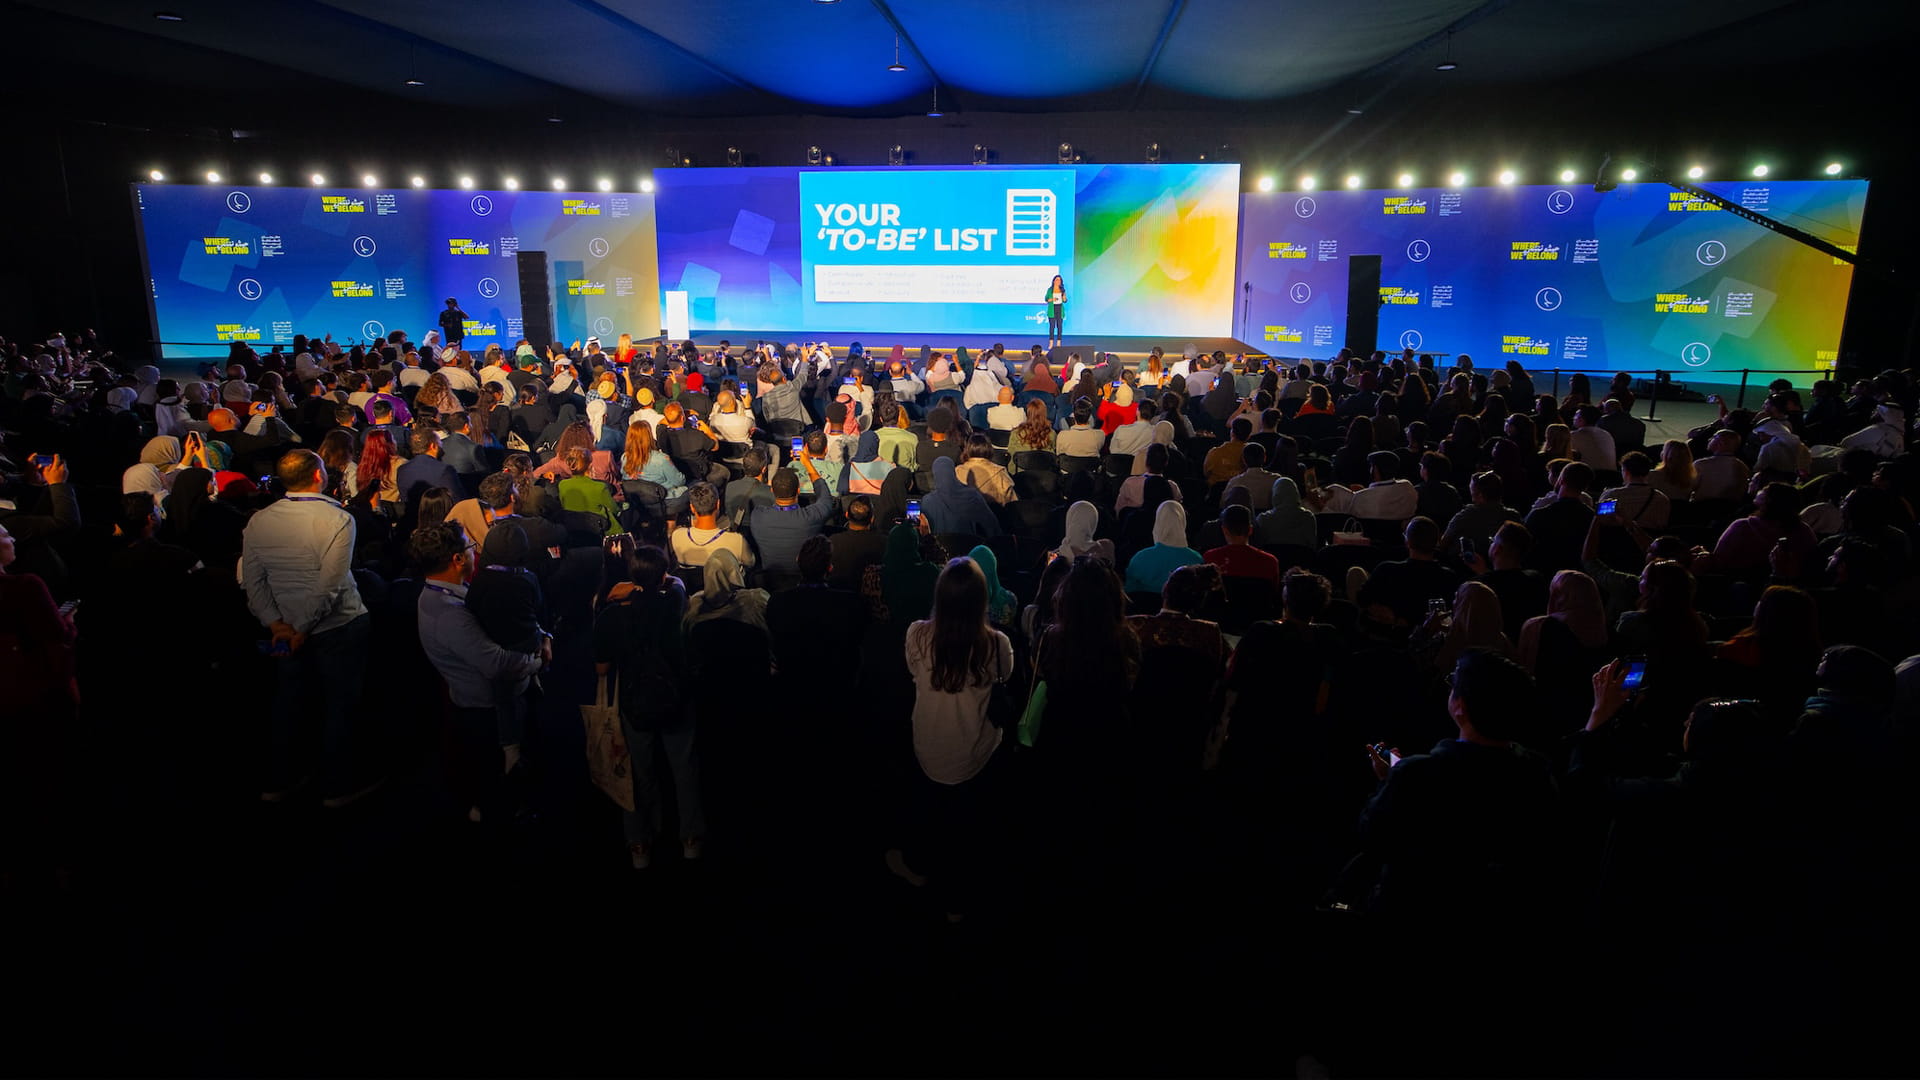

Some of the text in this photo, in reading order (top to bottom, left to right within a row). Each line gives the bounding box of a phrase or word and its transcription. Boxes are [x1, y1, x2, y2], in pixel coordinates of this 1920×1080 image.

[1670, 192, 1696, 200] WHE
[1384, 206, 1426, 214] WE BELONG
[1668, 202, 1682, 211] WE
[814, 203, 900, 226] YOUR
[934, 228, 998, 251] LIST
[1511, 252, 1558, 260] WE BELONG
[1655, 304, 1708, 312] WE BELONG
[1503, 345, 1548, 355] WE BELONG
